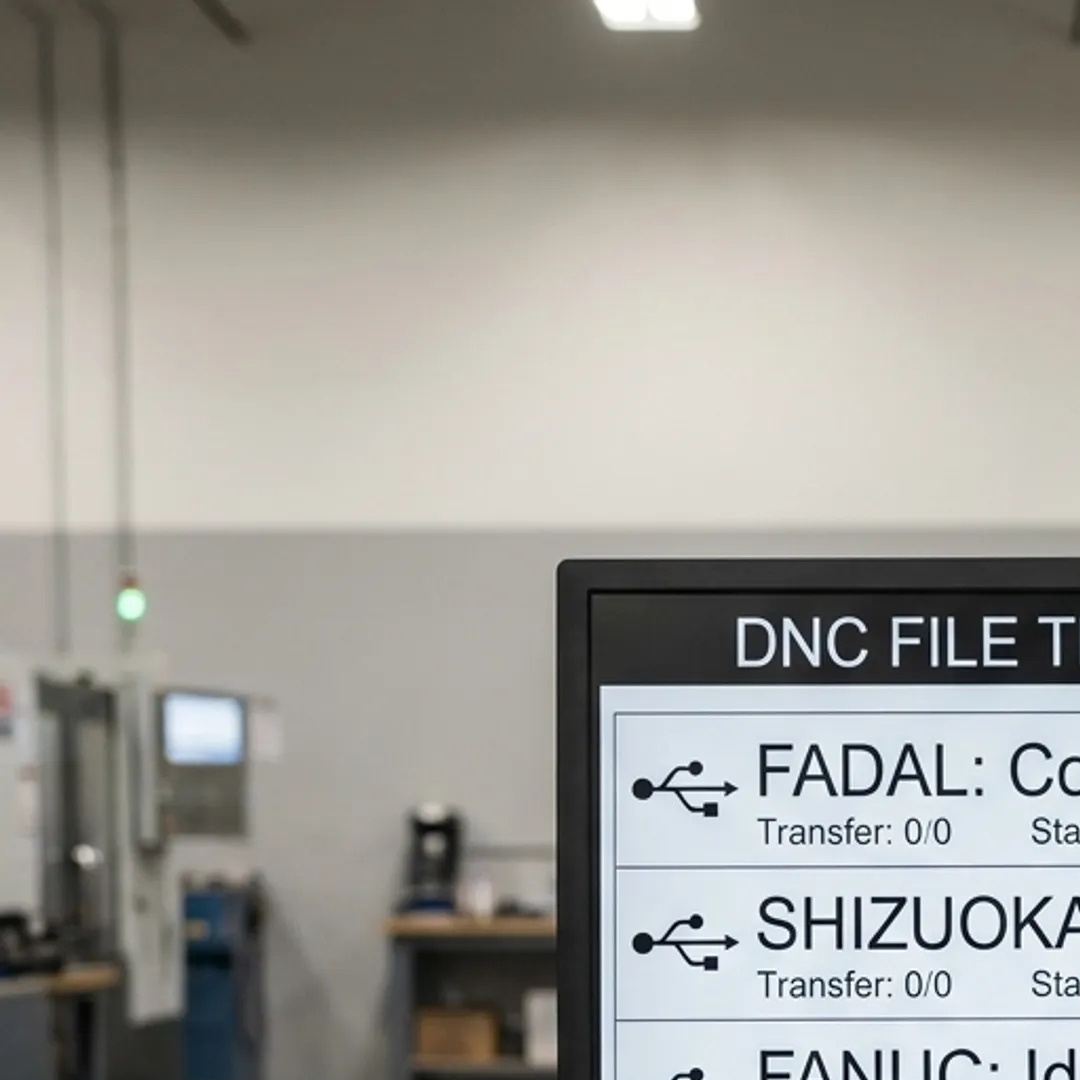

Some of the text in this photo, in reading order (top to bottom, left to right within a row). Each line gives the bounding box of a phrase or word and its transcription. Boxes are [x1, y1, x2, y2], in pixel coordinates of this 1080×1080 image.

[736, 616, 869, 668] DNC
[891, 616, 1019, 668] FILE
[759, 743, 984, 797] FADAL:
[757, 817, 892, 845] Transfer:
[905, 817, 951, 845] 0/0
[757, 970, 892, 998] Transfer:
[905, 970, 951, 998] 0/0
